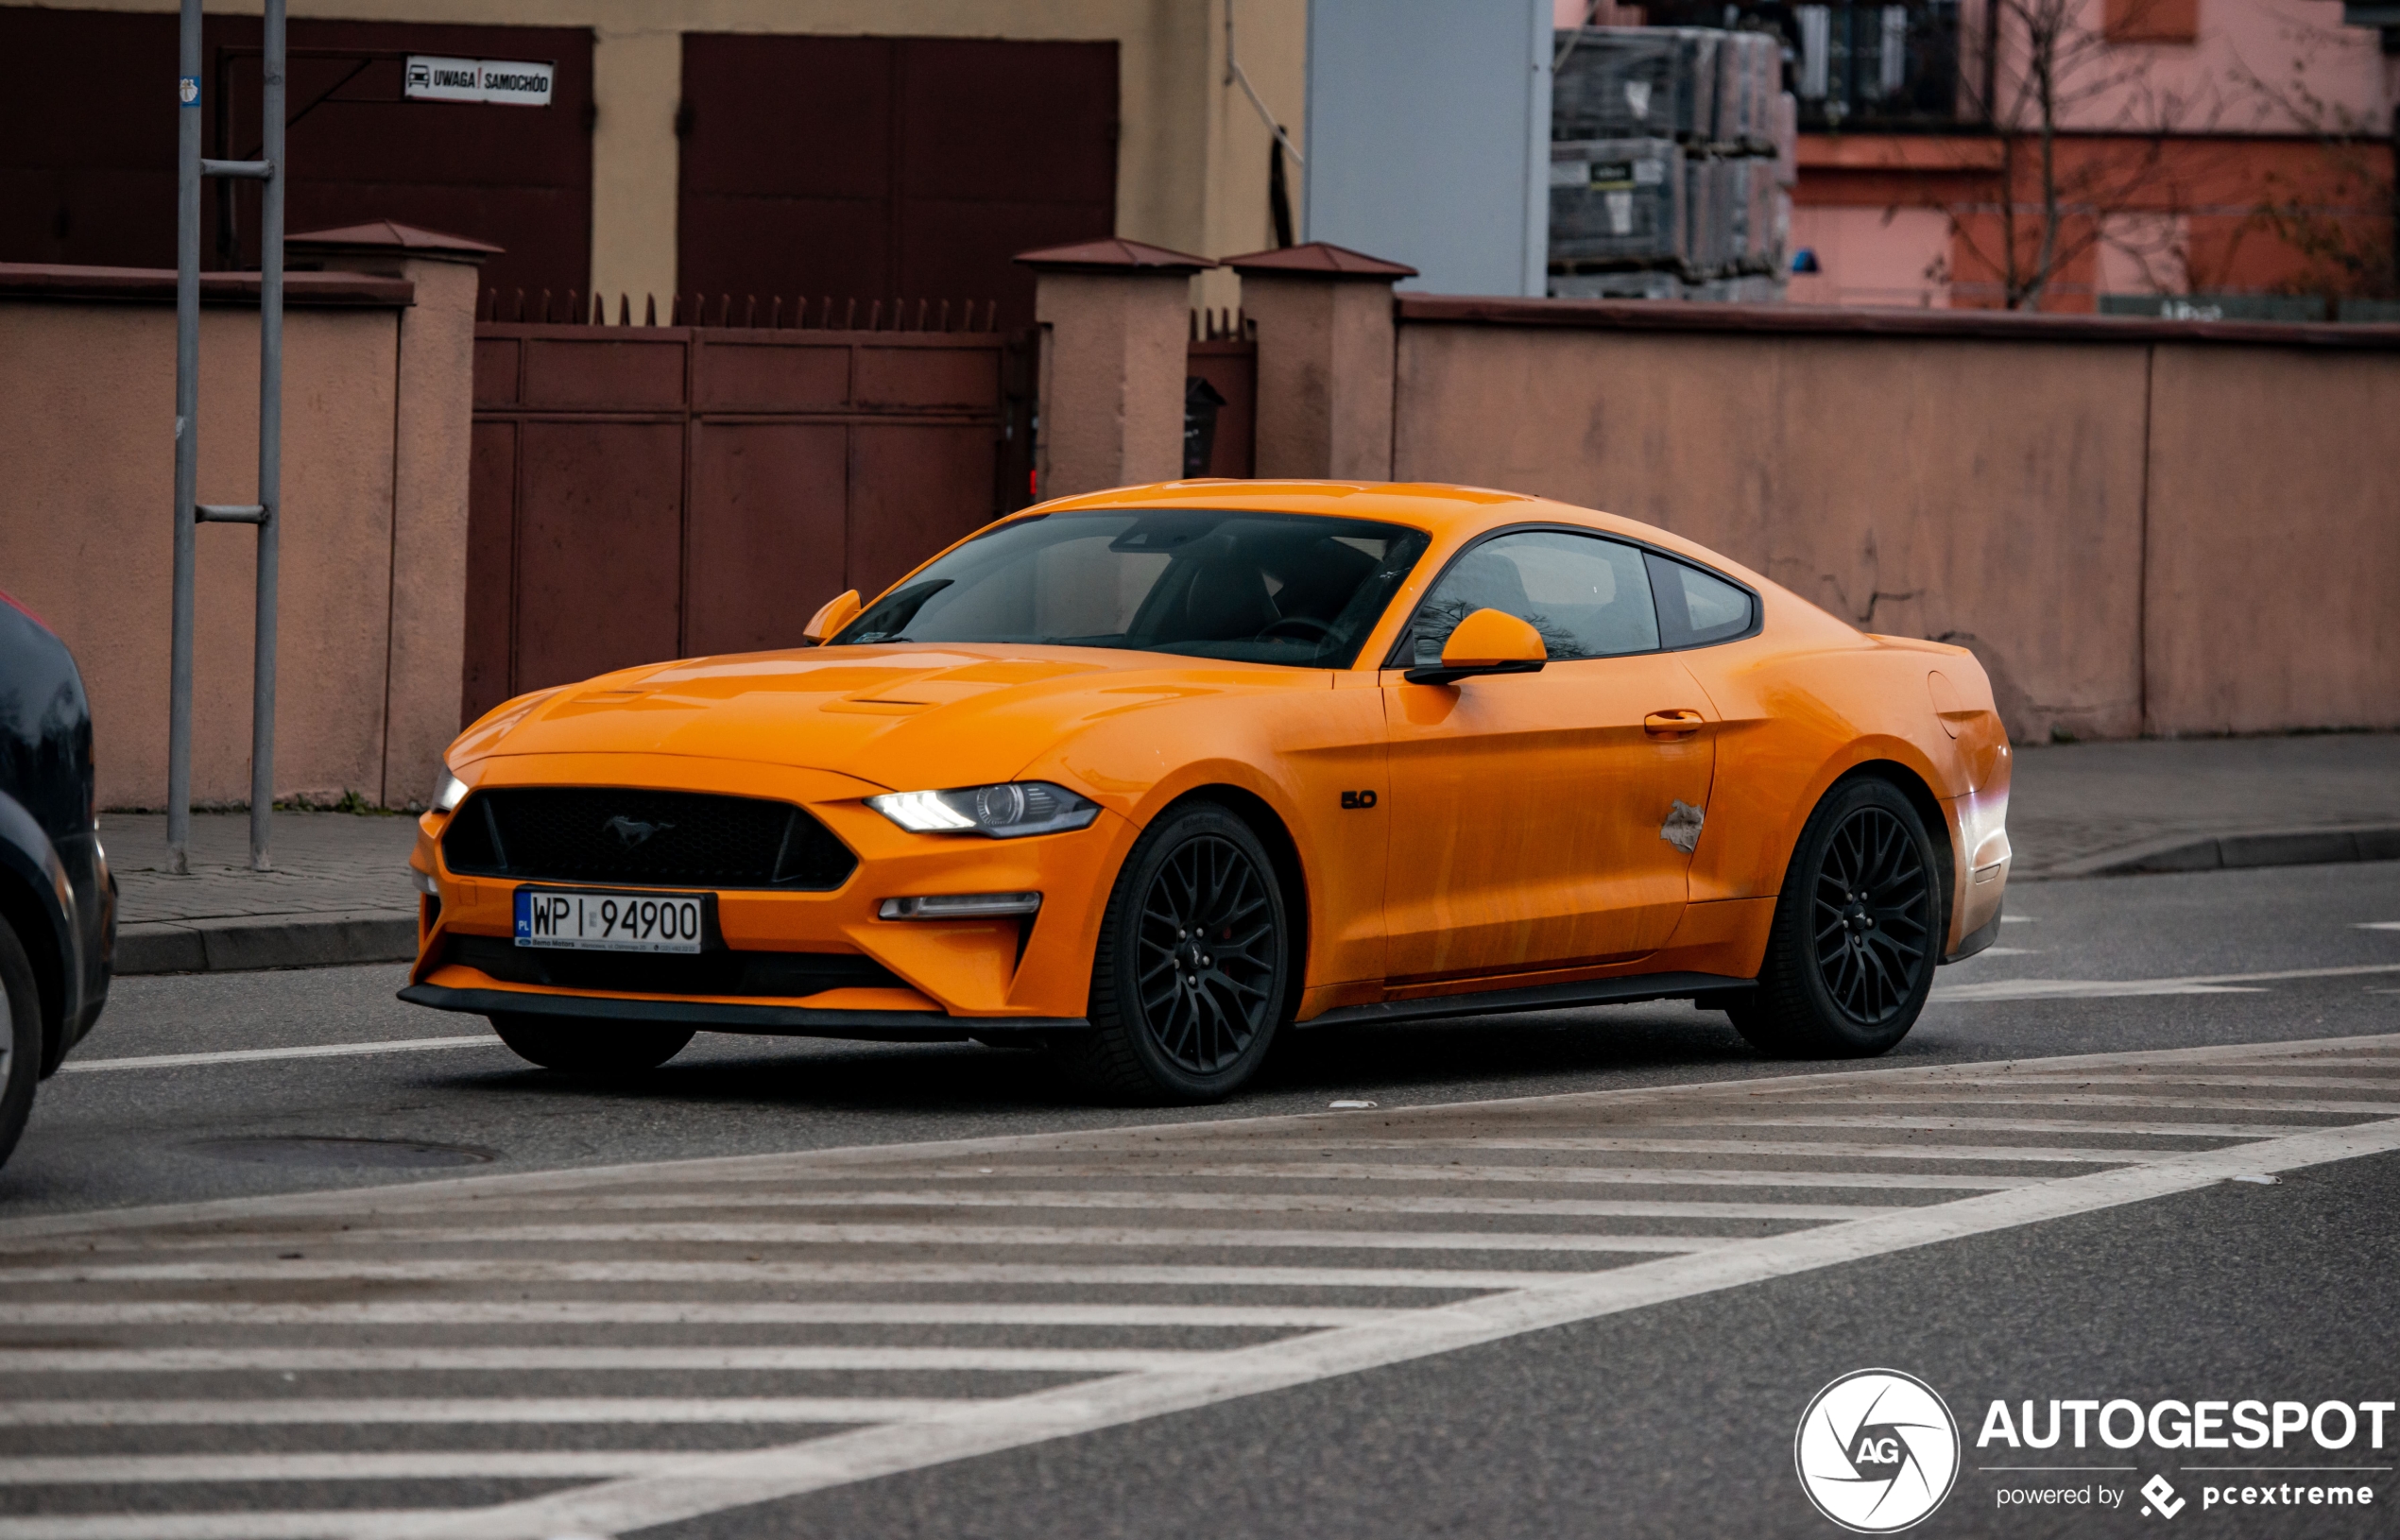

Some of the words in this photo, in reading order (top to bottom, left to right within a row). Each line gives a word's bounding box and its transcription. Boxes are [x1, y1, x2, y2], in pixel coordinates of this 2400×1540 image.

[484, 73, 548, 93] SAMOCHÓD
[519, 920, 529, 931] PL
[533, 897, 583, 936] WPI
[601, 899, 697, 940] 94900
